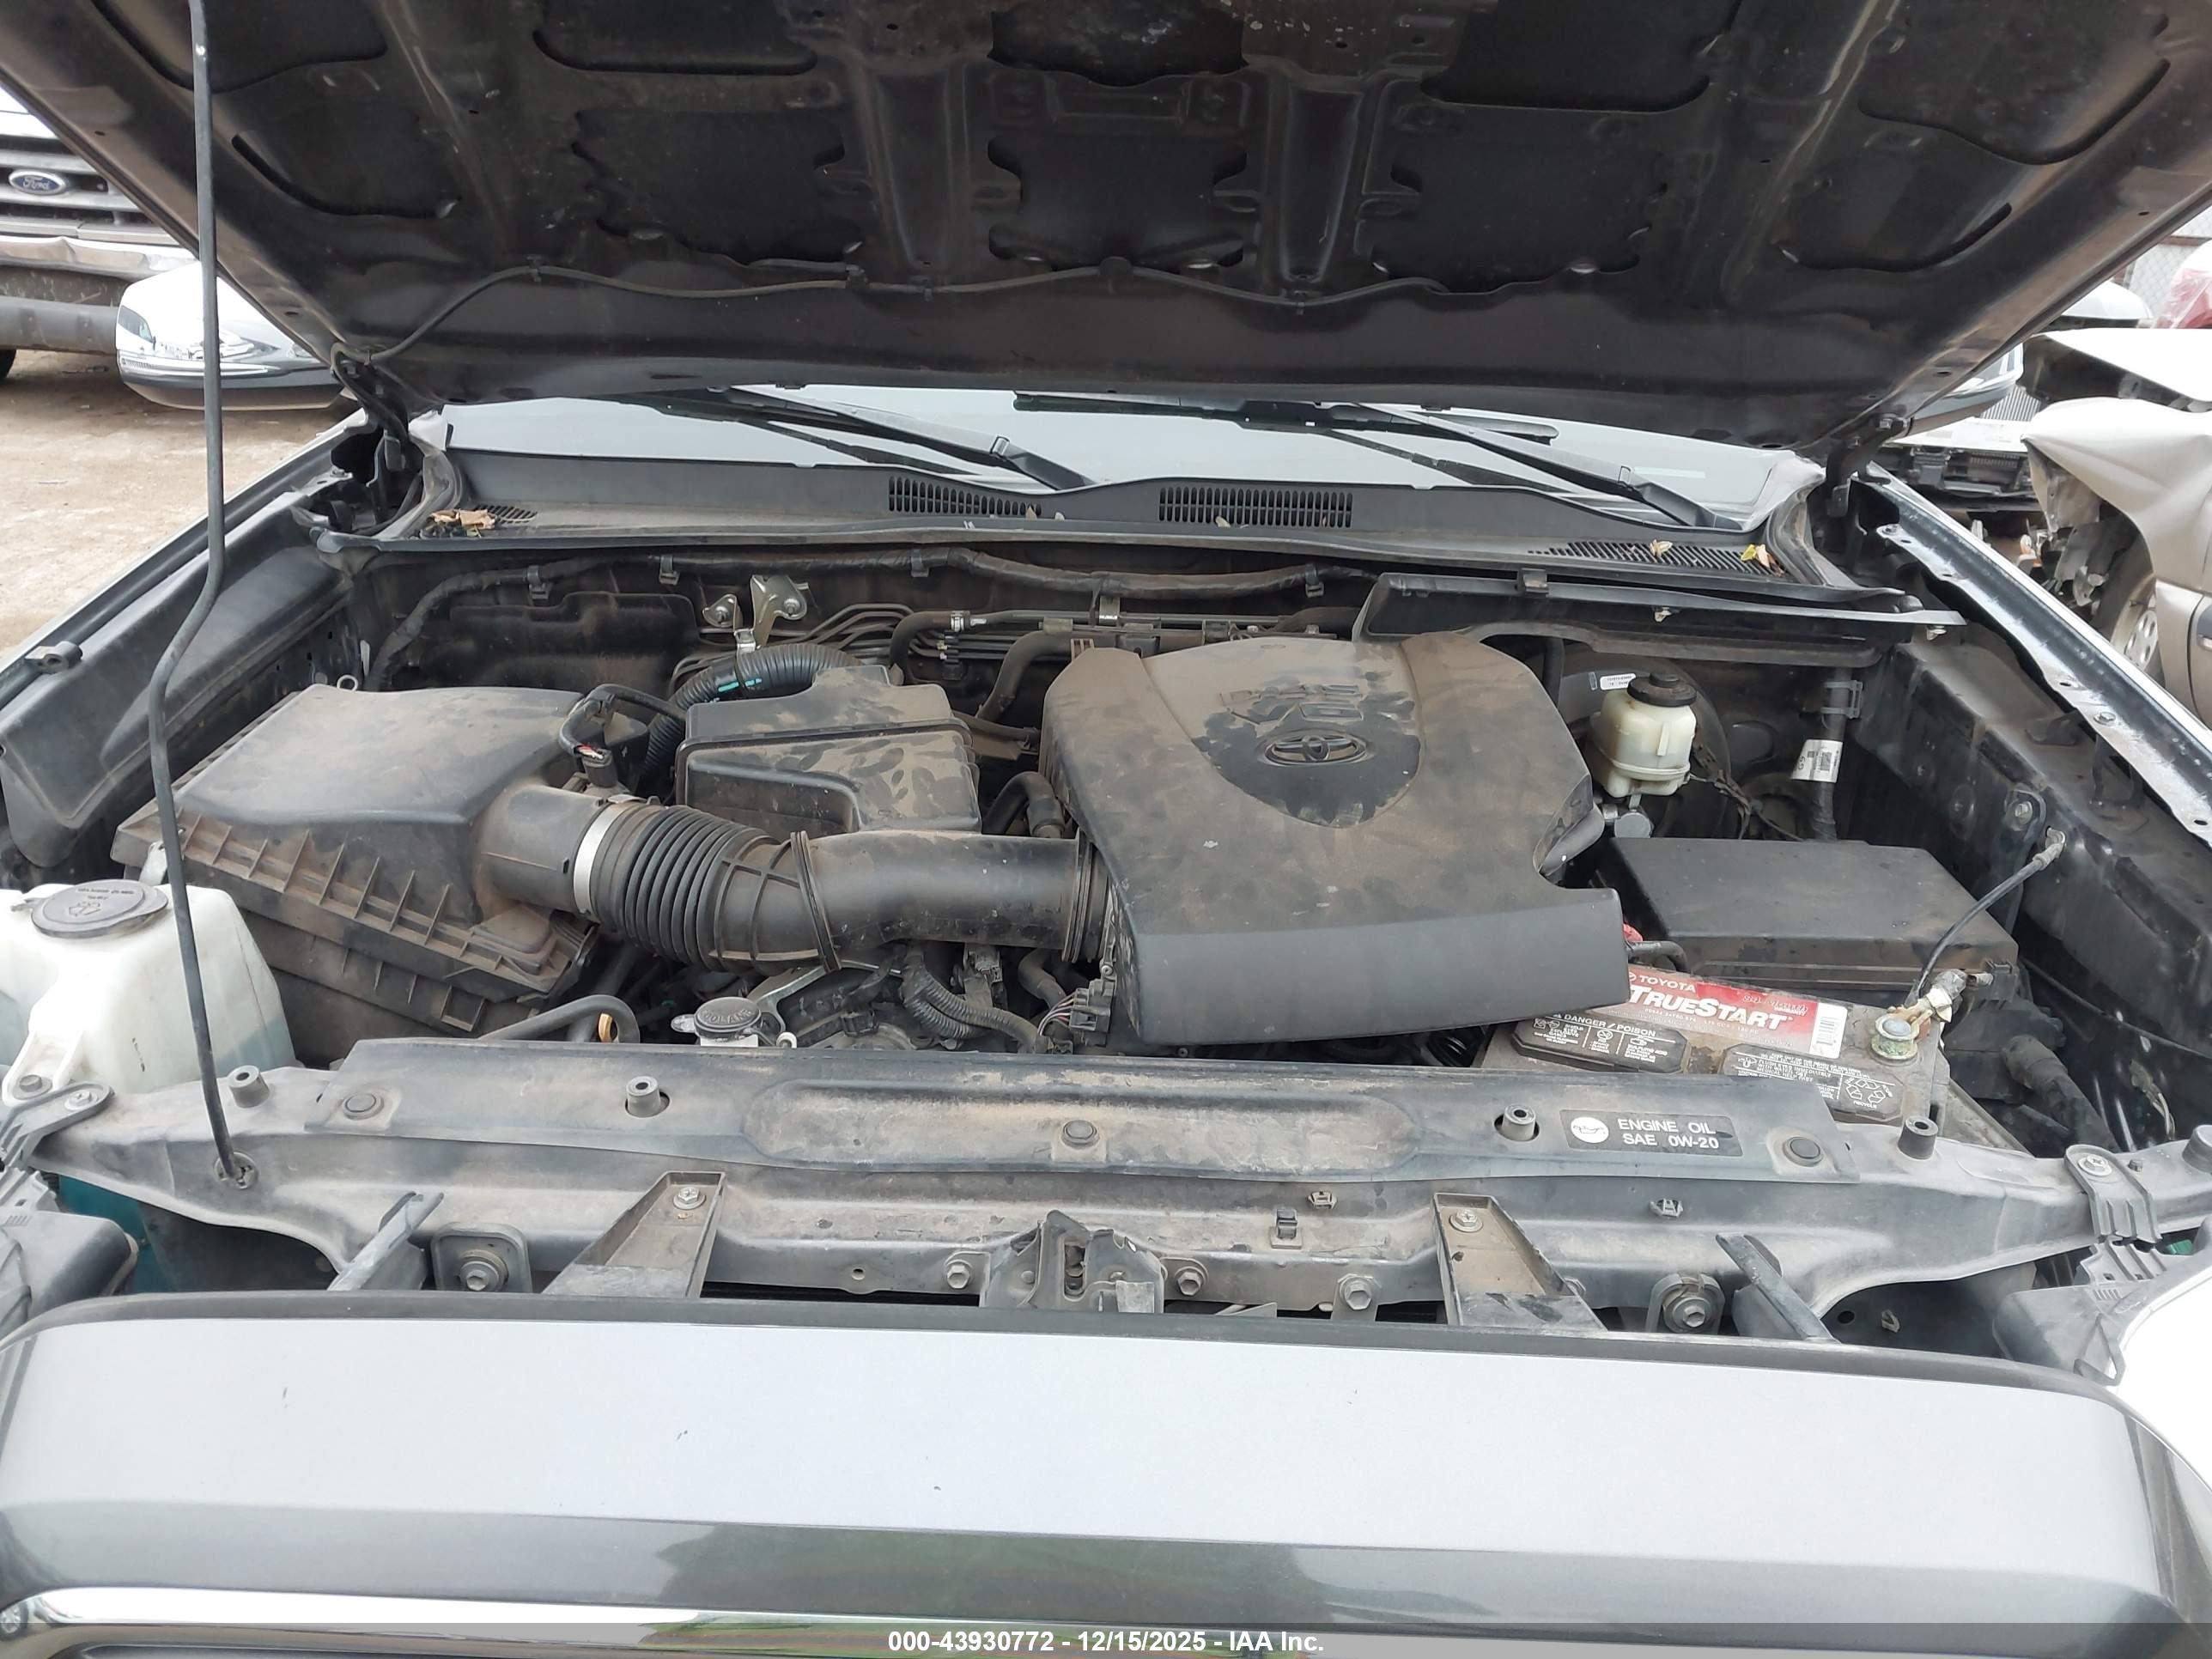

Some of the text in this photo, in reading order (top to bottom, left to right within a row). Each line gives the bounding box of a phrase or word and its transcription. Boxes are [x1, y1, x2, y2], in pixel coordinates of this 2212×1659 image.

[23, 176, 50, 191] Ford
[1639, 975, 1696, 994] TOYOTA
[1564, 1014, 1607, 1029] DANGER
[1616, 1024, 1656, 1037] POISON
[1618, 1118, 1717, 1134] ENGINE OIL
[1622, 1133, 1719, 1149] SAE 0W-20
